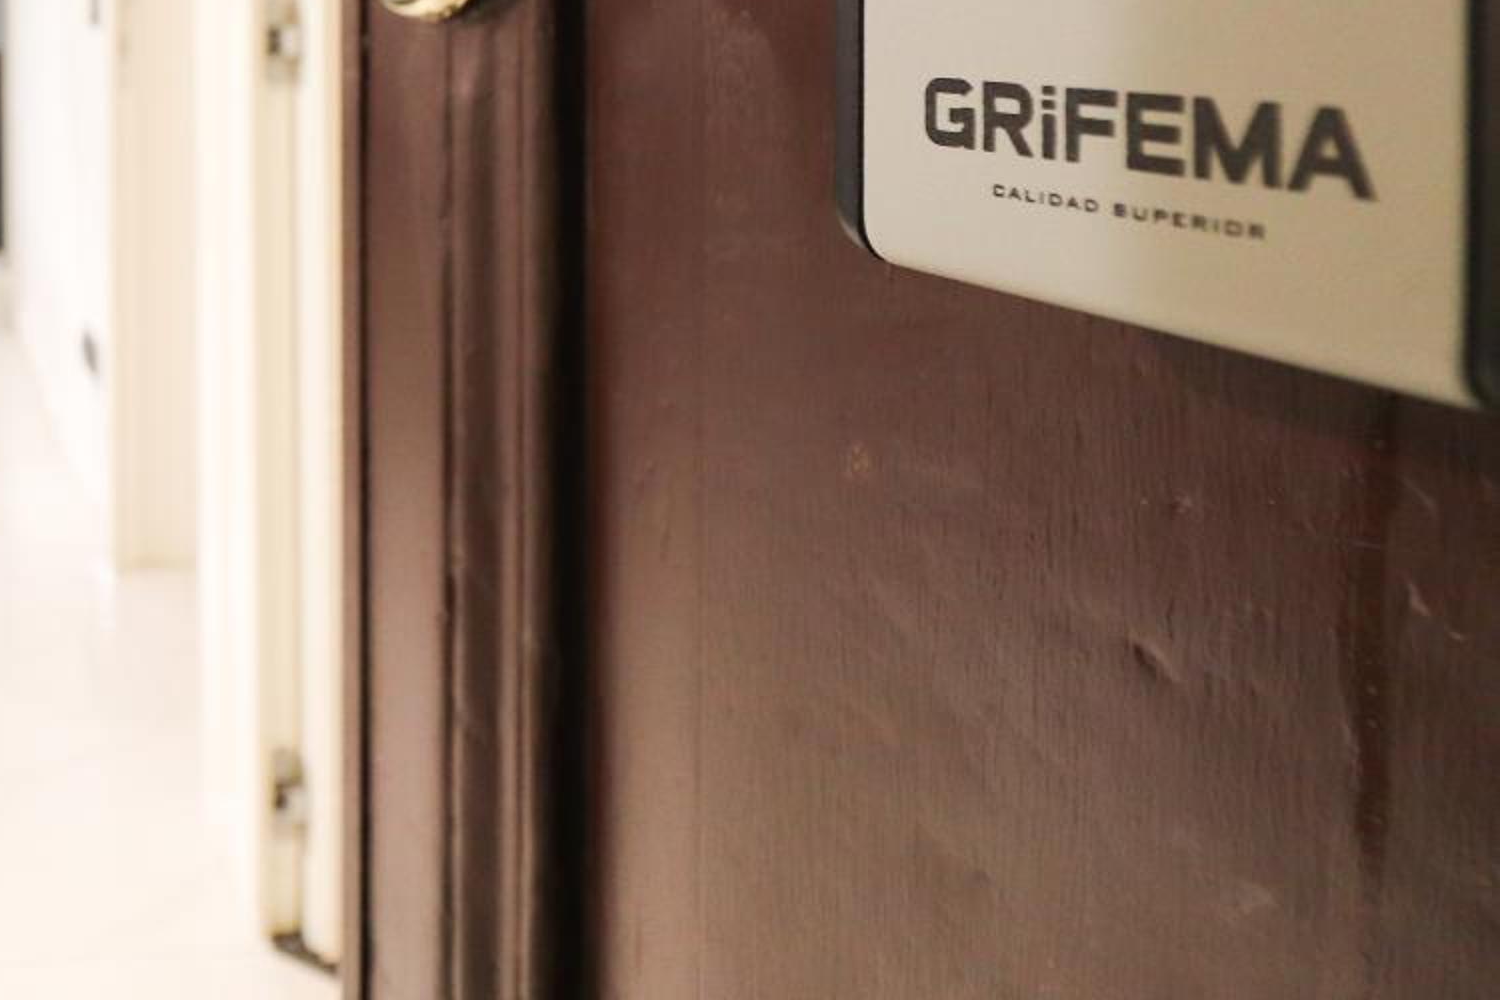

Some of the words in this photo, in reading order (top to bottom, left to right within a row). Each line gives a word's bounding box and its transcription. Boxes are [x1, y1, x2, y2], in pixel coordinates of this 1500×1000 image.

[924, 77, 1377, 201] GRiFEMA
[992, 184, 1099, 213] CALIDAD
[1113, 203, 1267, 240] SUPERIOR
